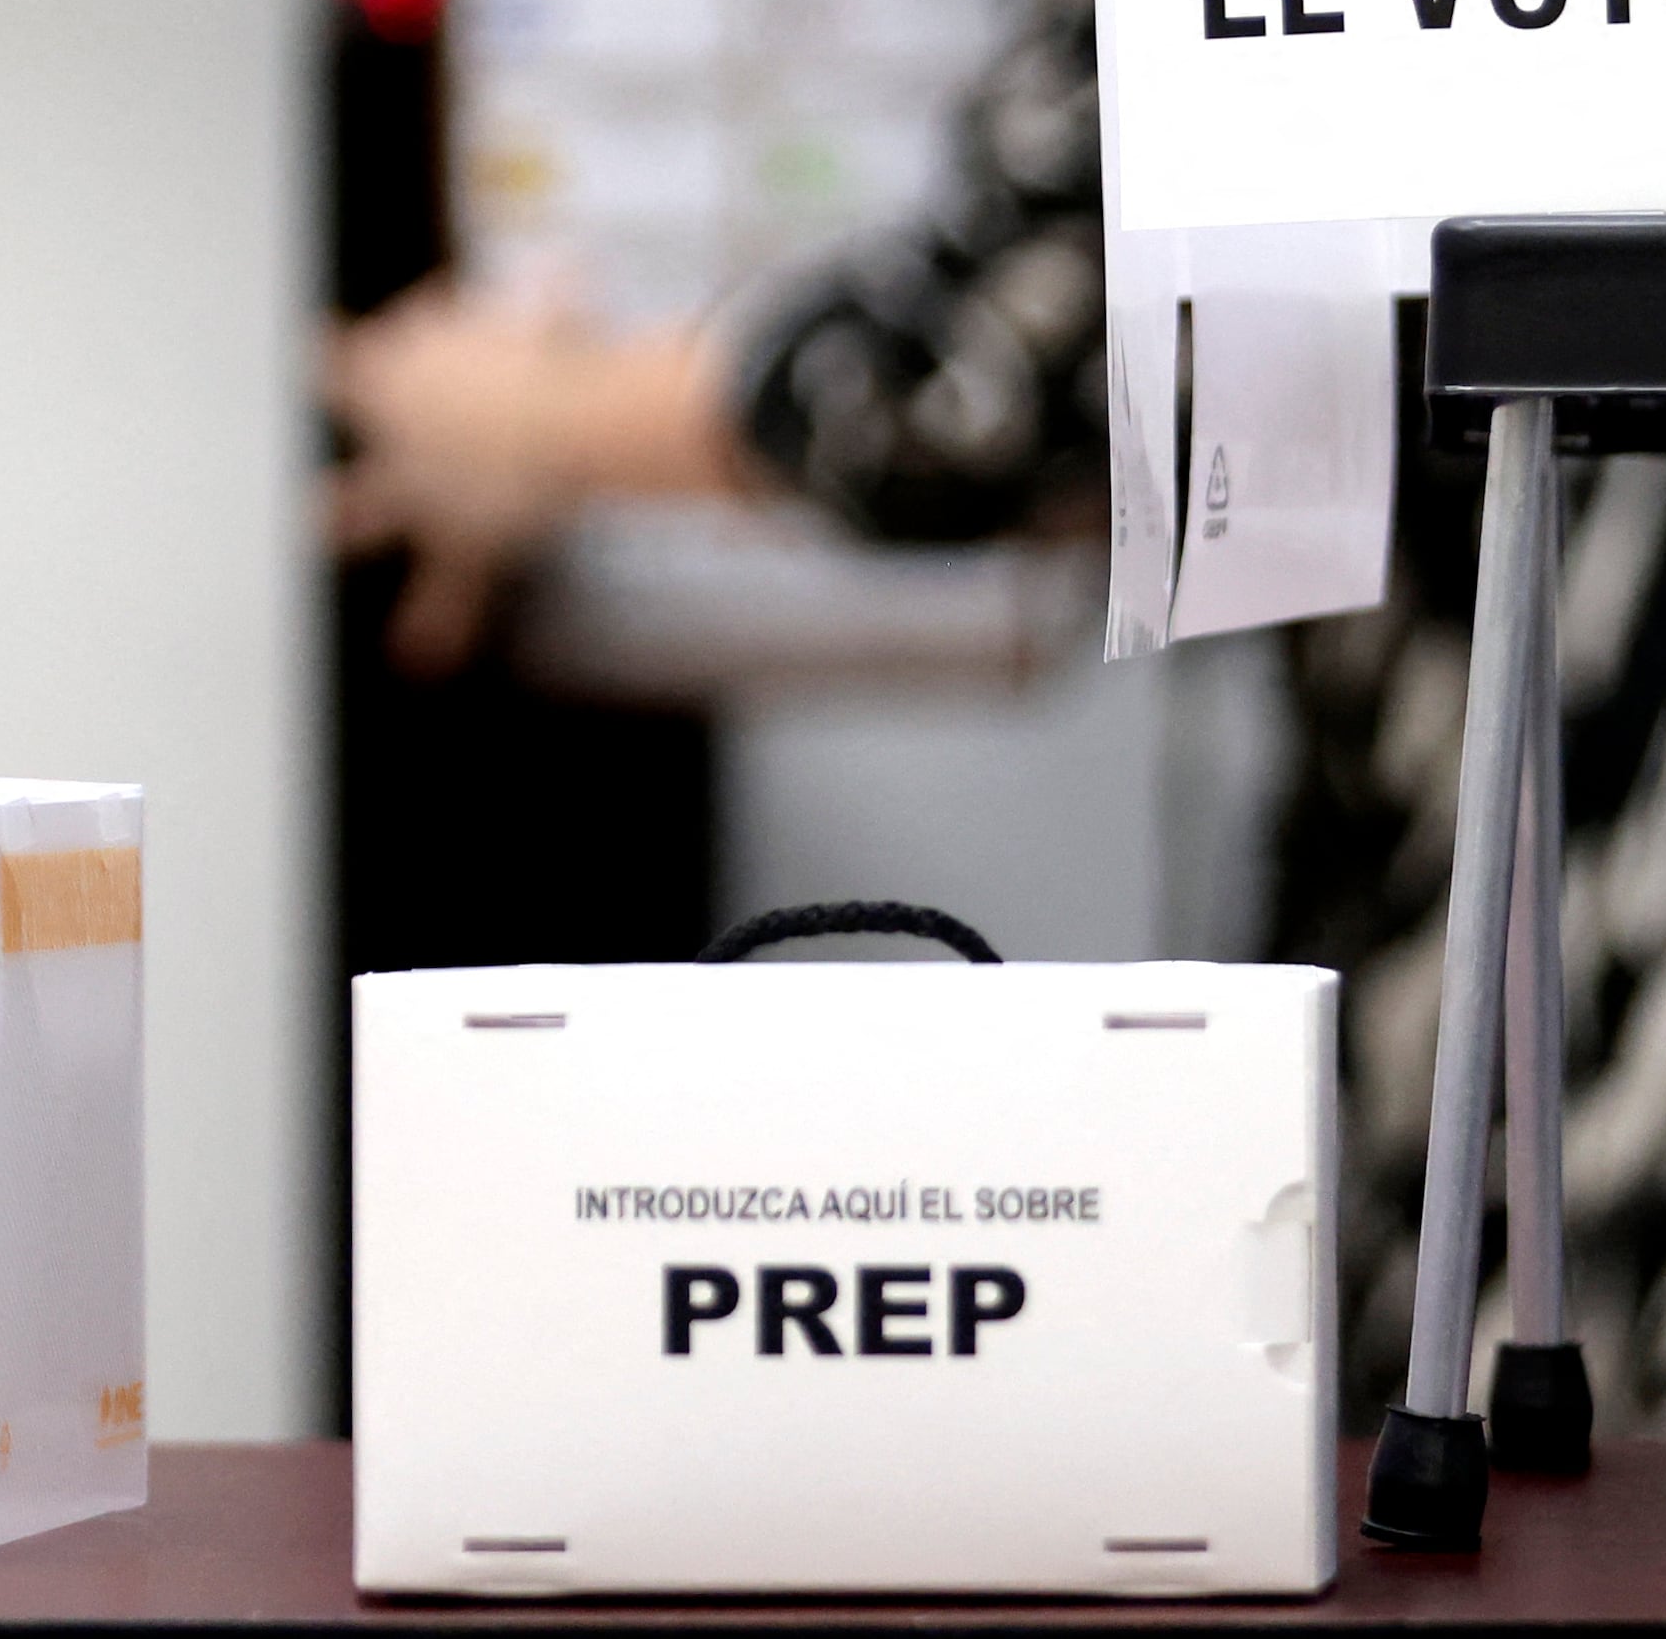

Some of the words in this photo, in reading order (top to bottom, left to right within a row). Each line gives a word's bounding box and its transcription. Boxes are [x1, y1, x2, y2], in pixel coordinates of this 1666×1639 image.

[575, 1187, 808, 1221] INTRODUZCA
[818, 1179, 908, 1223] AQUÍ
[919, 1187, 963, 1221] EL
[974, 1186, 1101, 1222] SOBRE
[660, 1263, 1027, 1358] PREP
